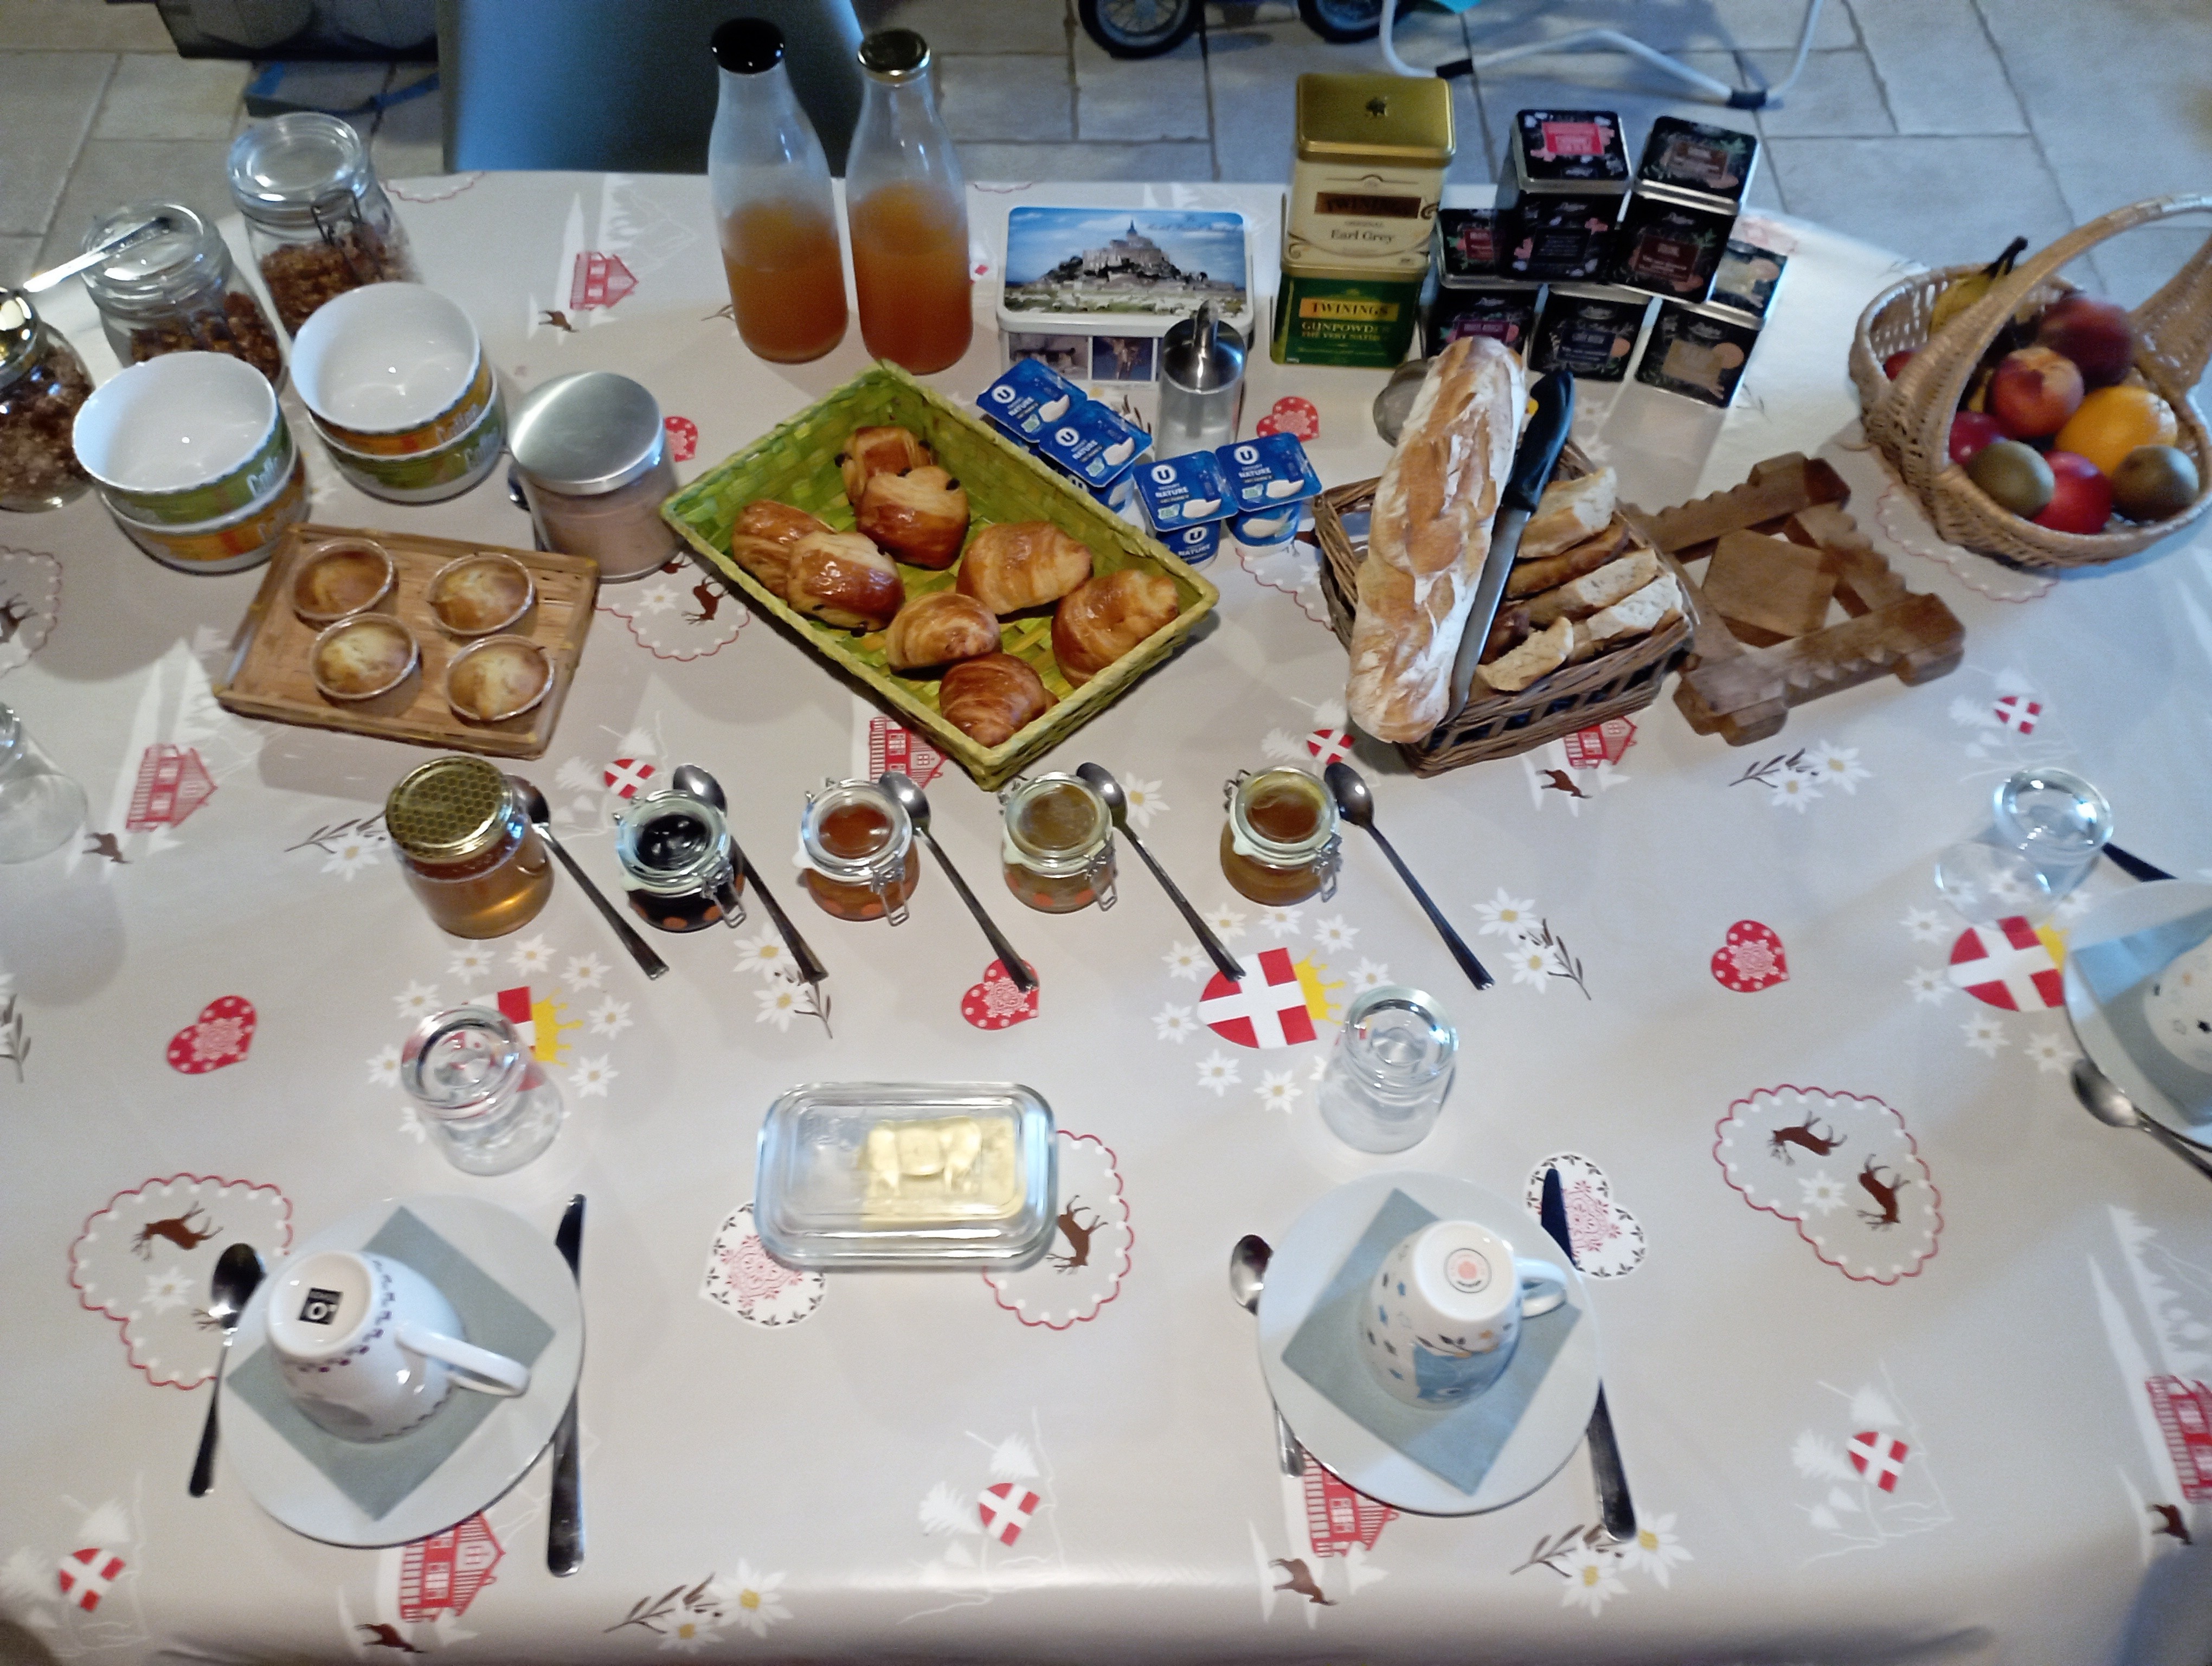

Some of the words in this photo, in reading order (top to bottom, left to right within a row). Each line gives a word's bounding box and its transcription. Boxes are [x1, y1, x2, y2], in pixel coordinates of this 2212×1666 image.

[1331, 229, 1359, 240] Earl
[1362, 230, 1394, 244] Grey
[1311, 302, 1388, 315] TWININGS
